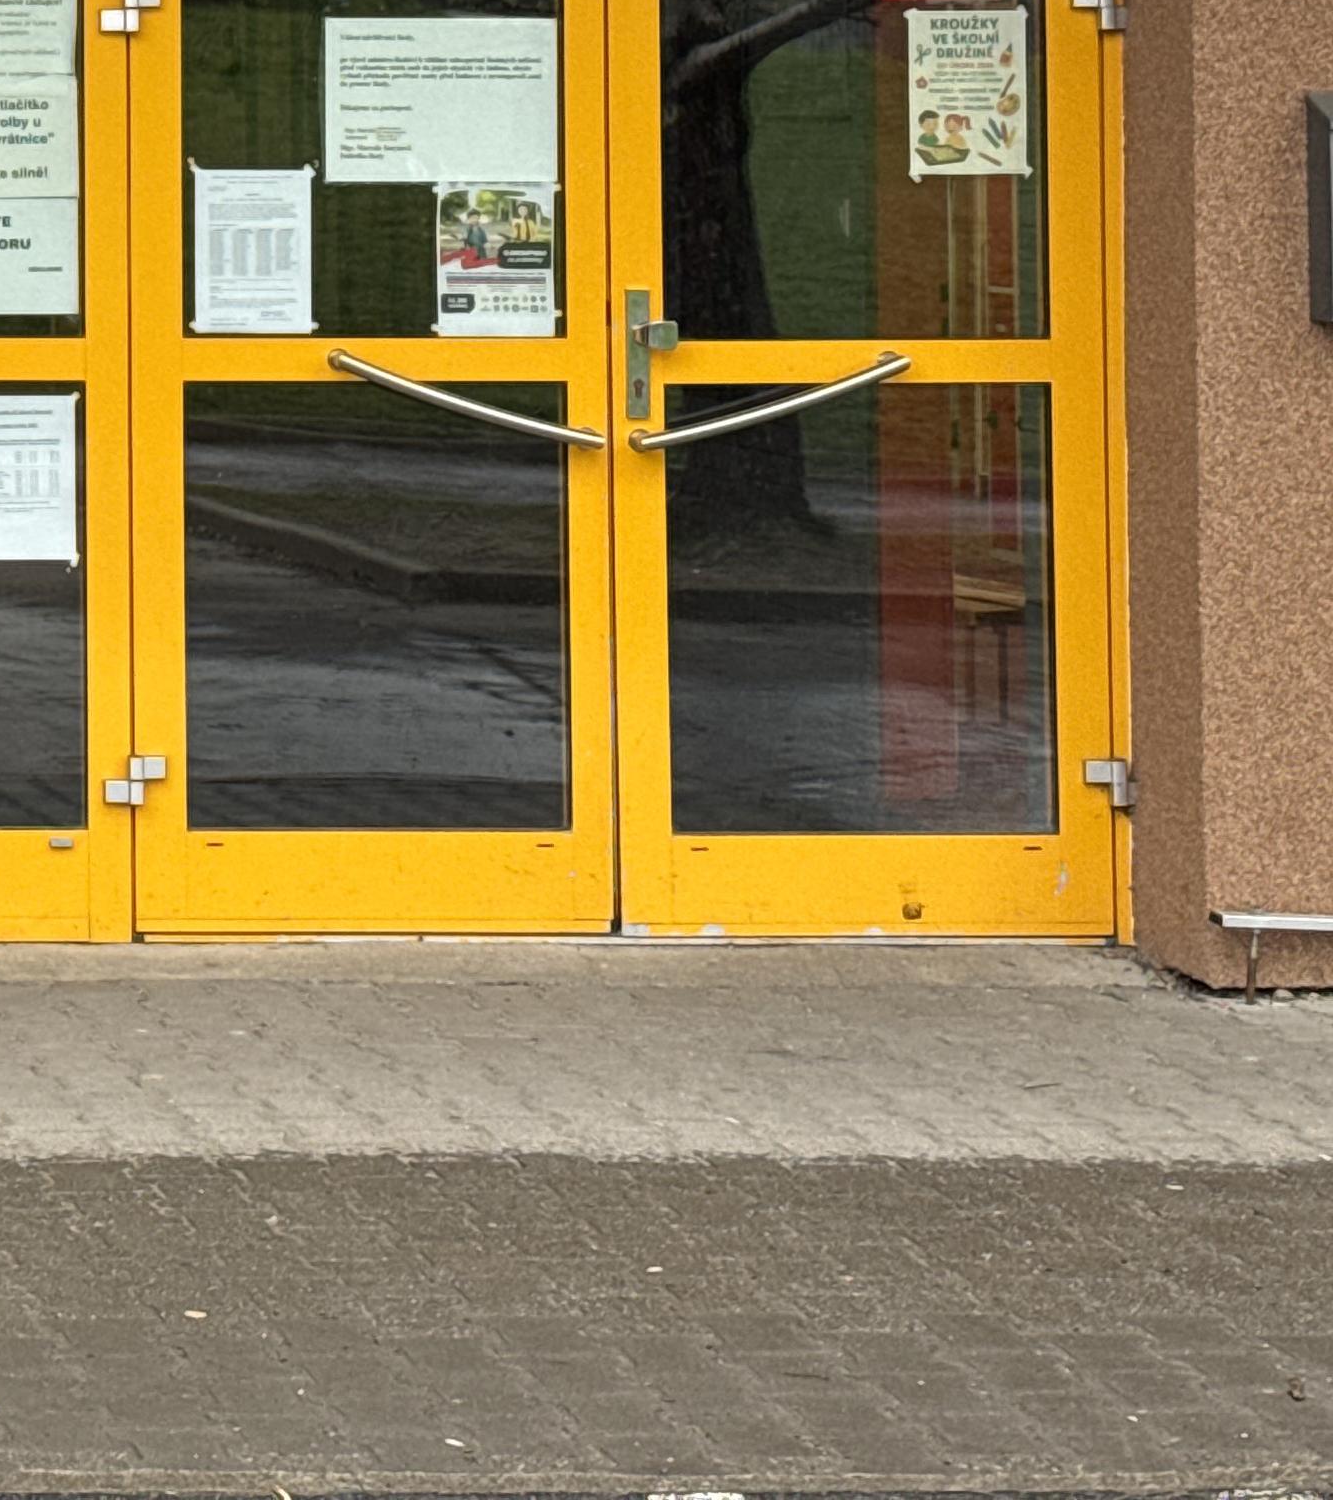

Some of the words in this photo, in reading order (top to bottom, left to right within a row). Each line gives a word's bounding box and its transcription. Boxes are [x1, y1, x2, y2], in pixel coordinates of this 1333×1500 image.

[930, 15, 999, 31] KROUŽKY
[932, 33, 948, 45] VE
[952, 31, 999, 45] ŠKOLNÍ
[936, 44, 995, 59] DRUŽINĚ
[0, 99, 49, 111] tlačítko
[33, 118, 42, 128] u
[11, 166, 48, 180] silně!
